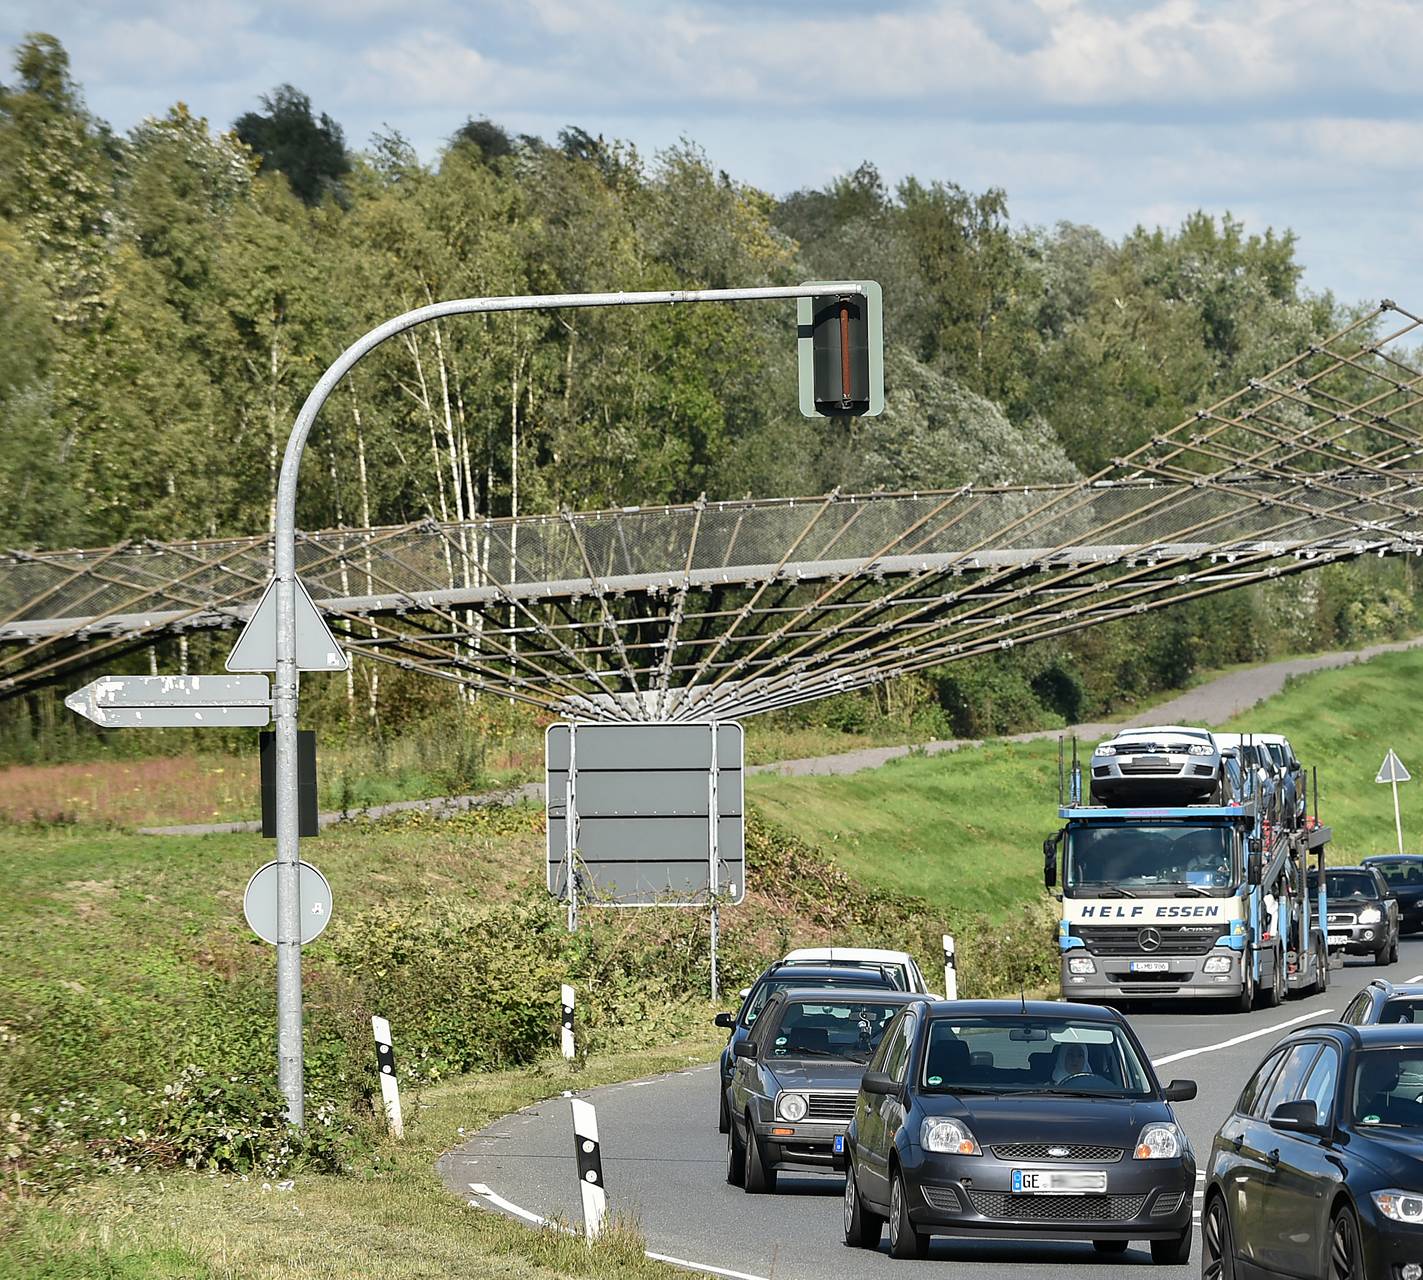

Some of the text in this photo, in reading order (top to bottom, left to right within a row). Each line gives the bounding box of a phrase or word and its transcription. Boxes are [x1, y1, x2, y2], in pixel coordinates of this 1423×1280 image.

[1081, 906, 1219, 917] HELF ESSEN
[1023, 1174, 1040, 1189] GE
